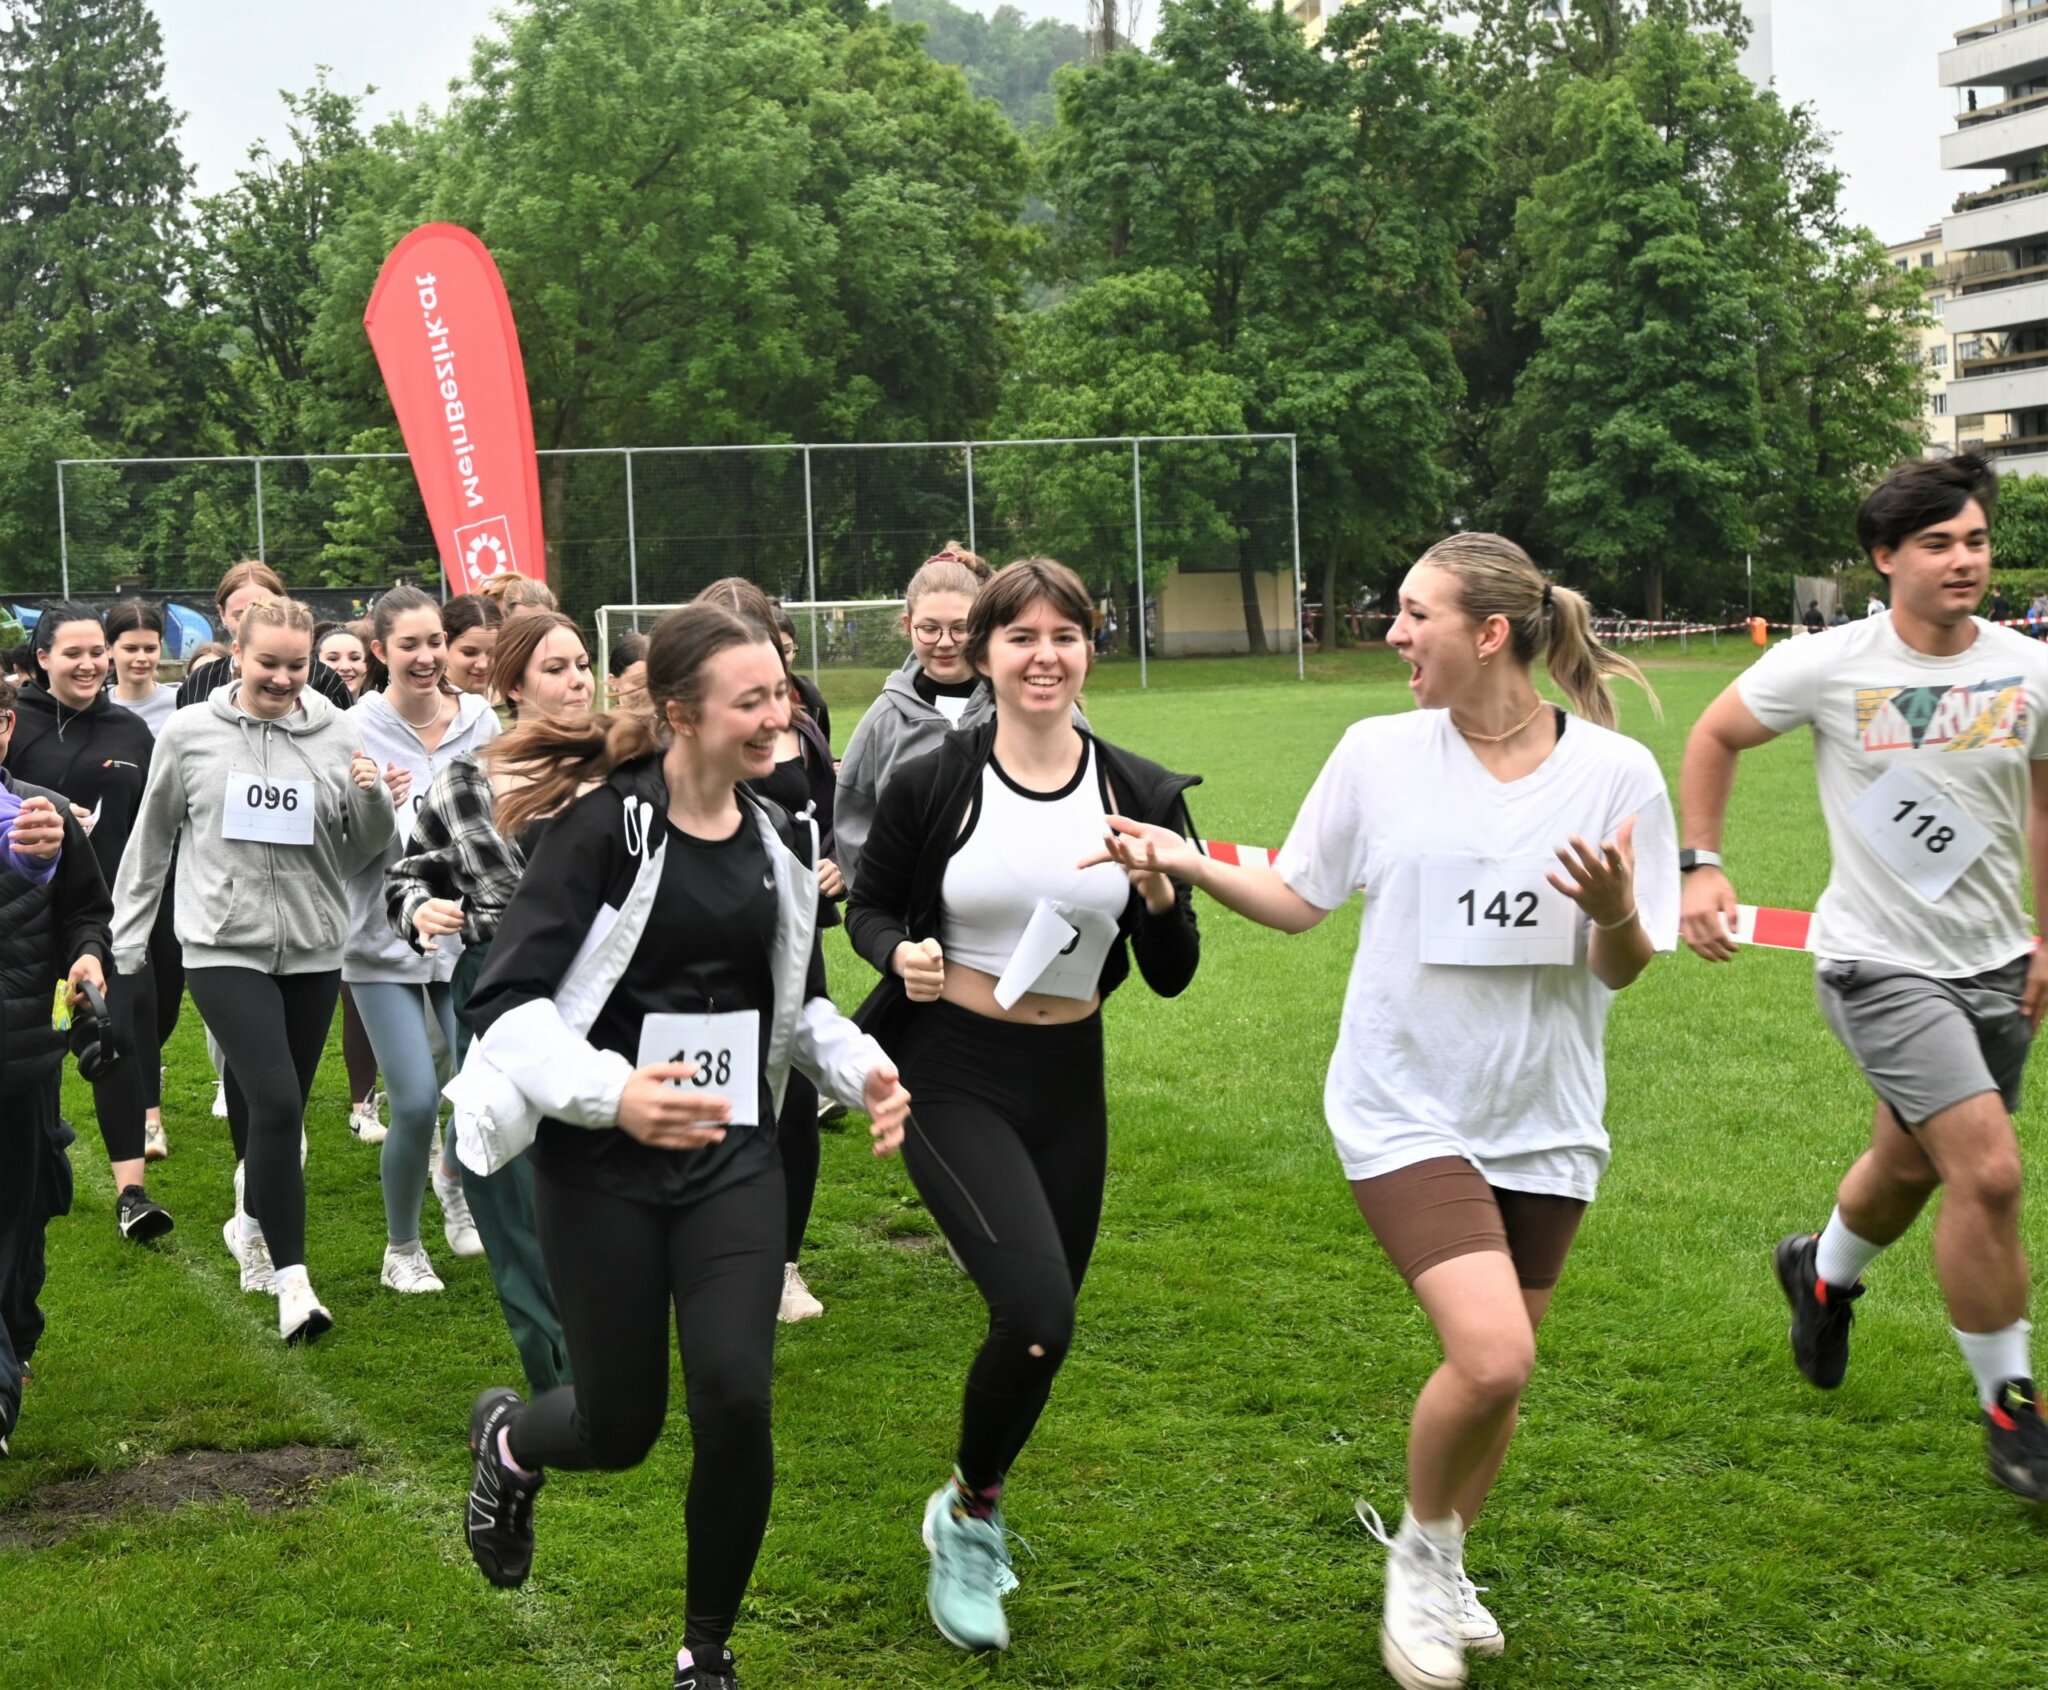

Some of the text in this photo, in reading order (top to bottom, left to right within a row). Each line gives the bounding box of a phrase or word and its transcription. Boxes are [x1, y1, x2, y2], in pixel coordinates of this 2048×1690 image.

[1863, 684, 2025, 751] MARVL
[247, 785, 297, 810] 096
[1892, 801, 1954, 853] 118
[1458, 890, 1537, 927] 142
[668, 1049, 731, 1087] 138
